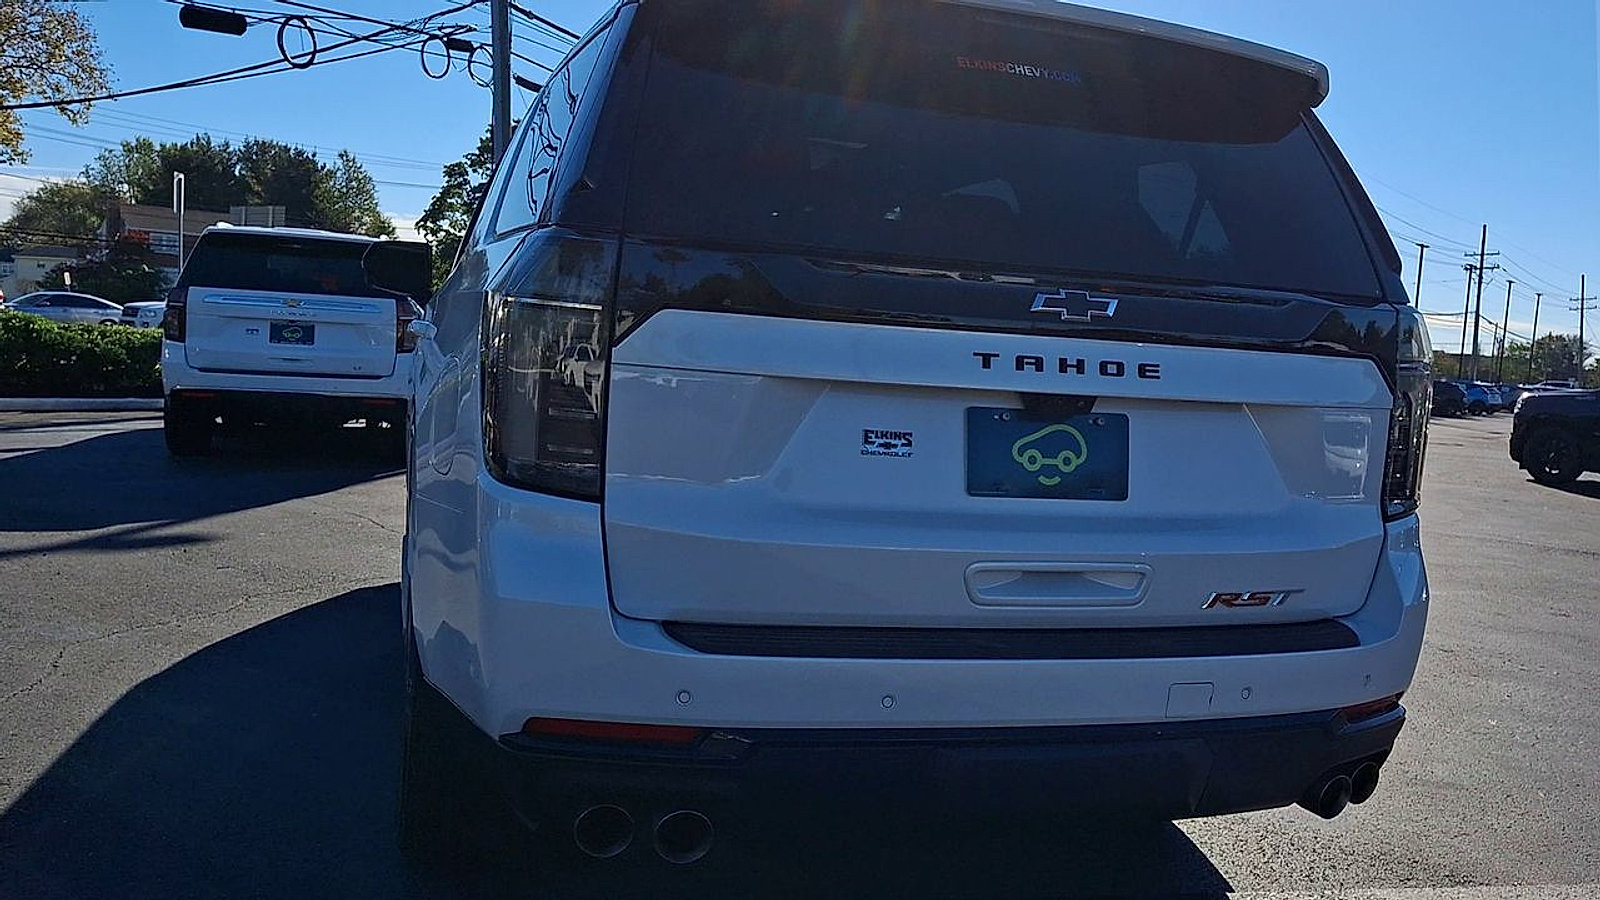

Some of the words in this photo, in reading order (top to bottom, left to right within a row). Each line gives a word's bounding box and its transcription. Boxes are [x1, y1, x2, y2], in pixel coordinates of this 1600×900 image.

[973, 352, 1161, 380] TAHOE
[862, 429, 913, 448] ELKINS
[1201, 588, 1306, 610] RST
